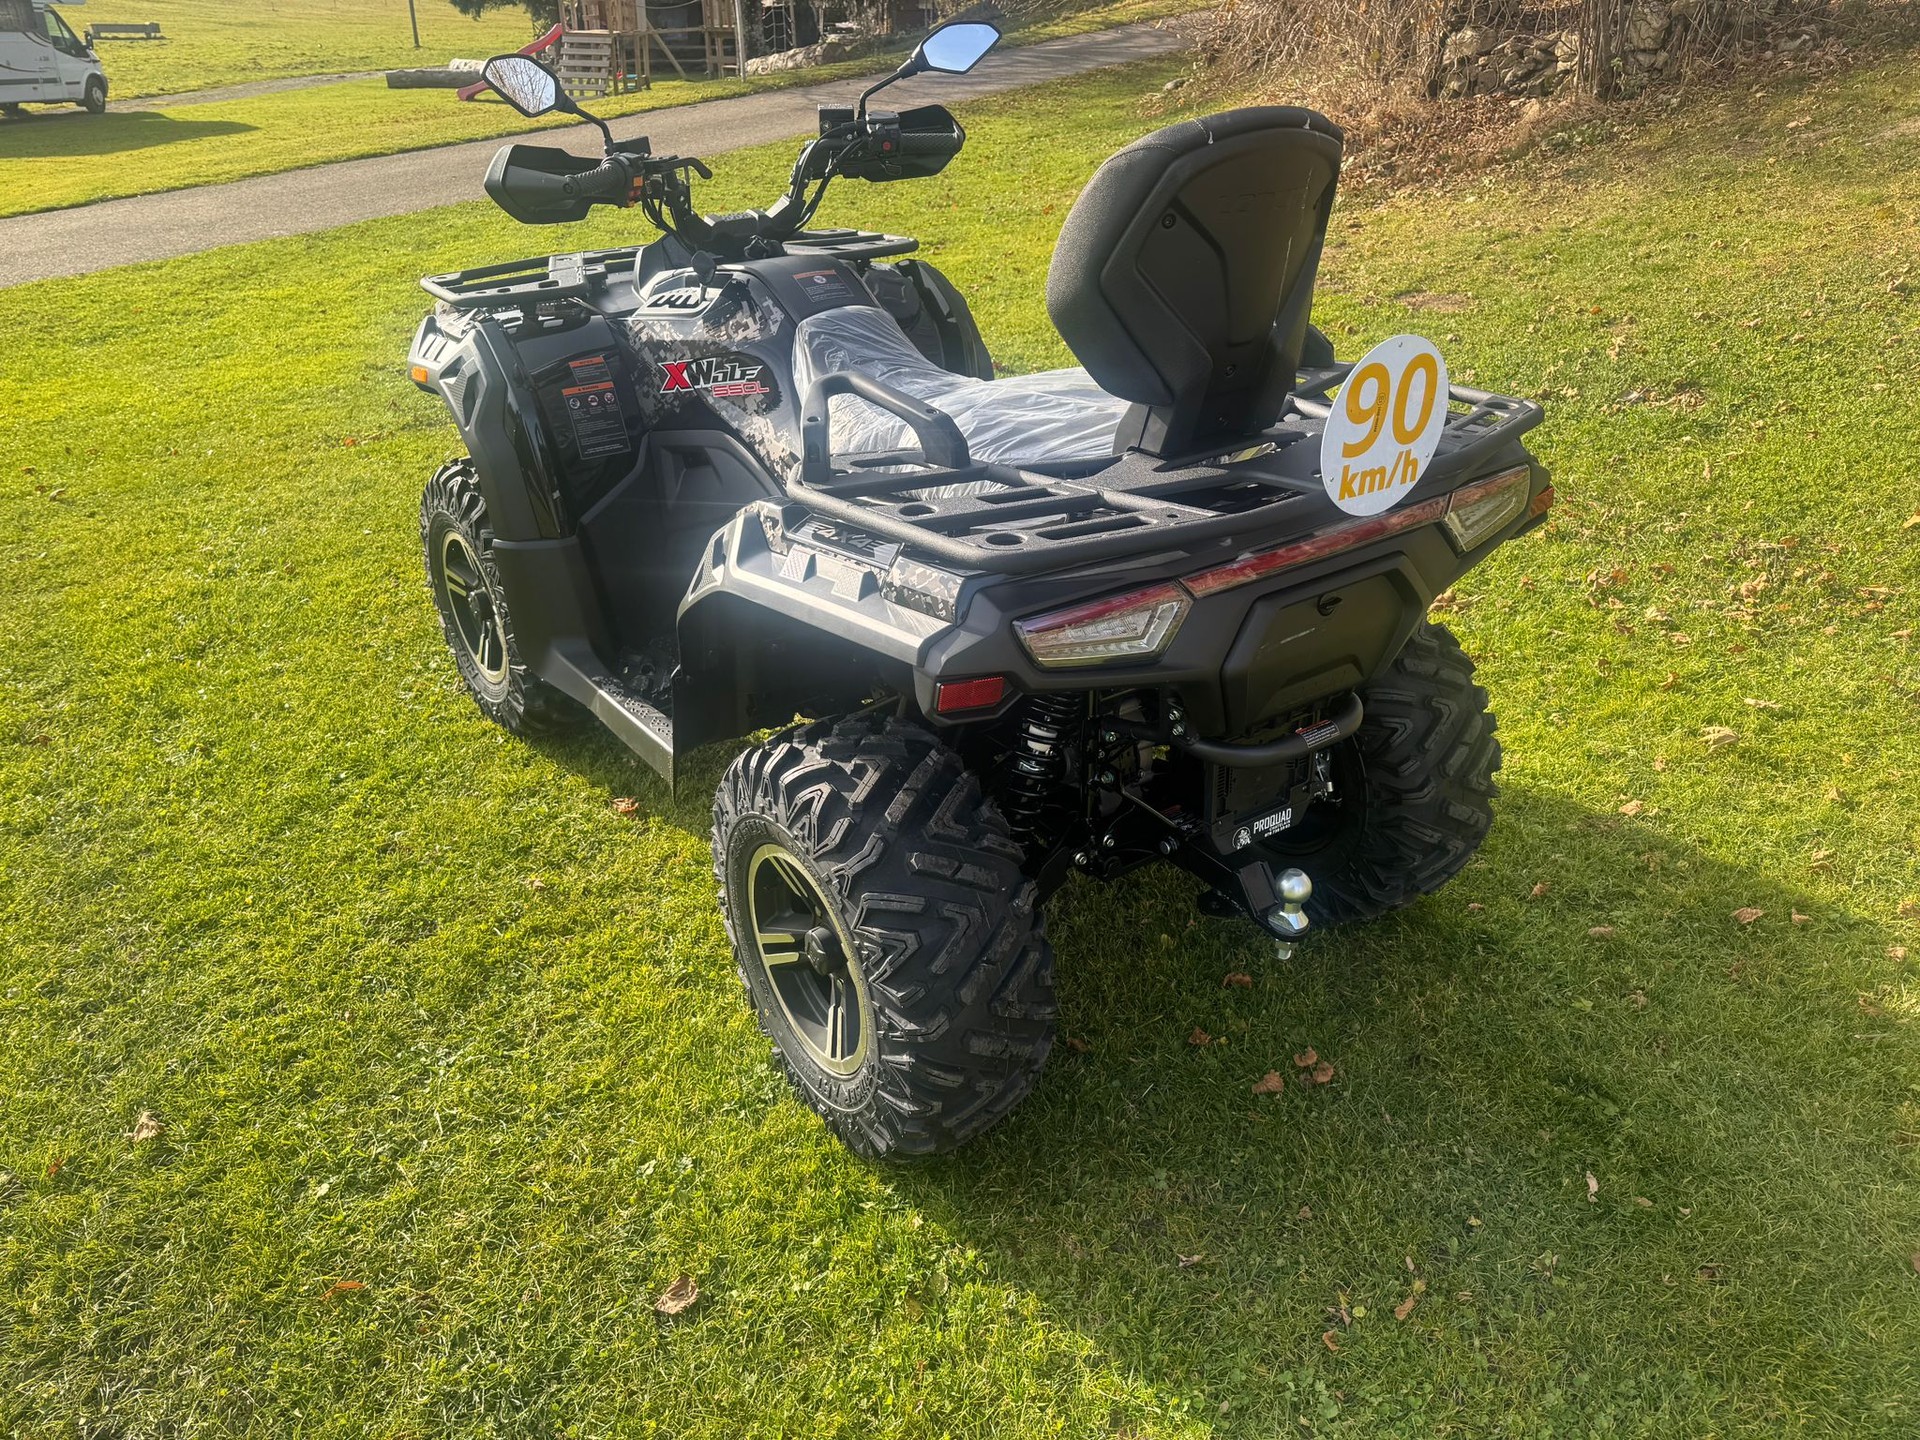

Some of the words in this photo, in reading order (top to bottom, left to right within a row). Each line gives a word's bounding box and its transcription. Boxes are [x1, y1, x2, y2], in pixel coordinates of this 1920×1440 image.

[1341, 353, 1438, 459] 90
[1338, 449, 1419, 501] km/h
[1253, 808, 1292, 834] PROQUAD
